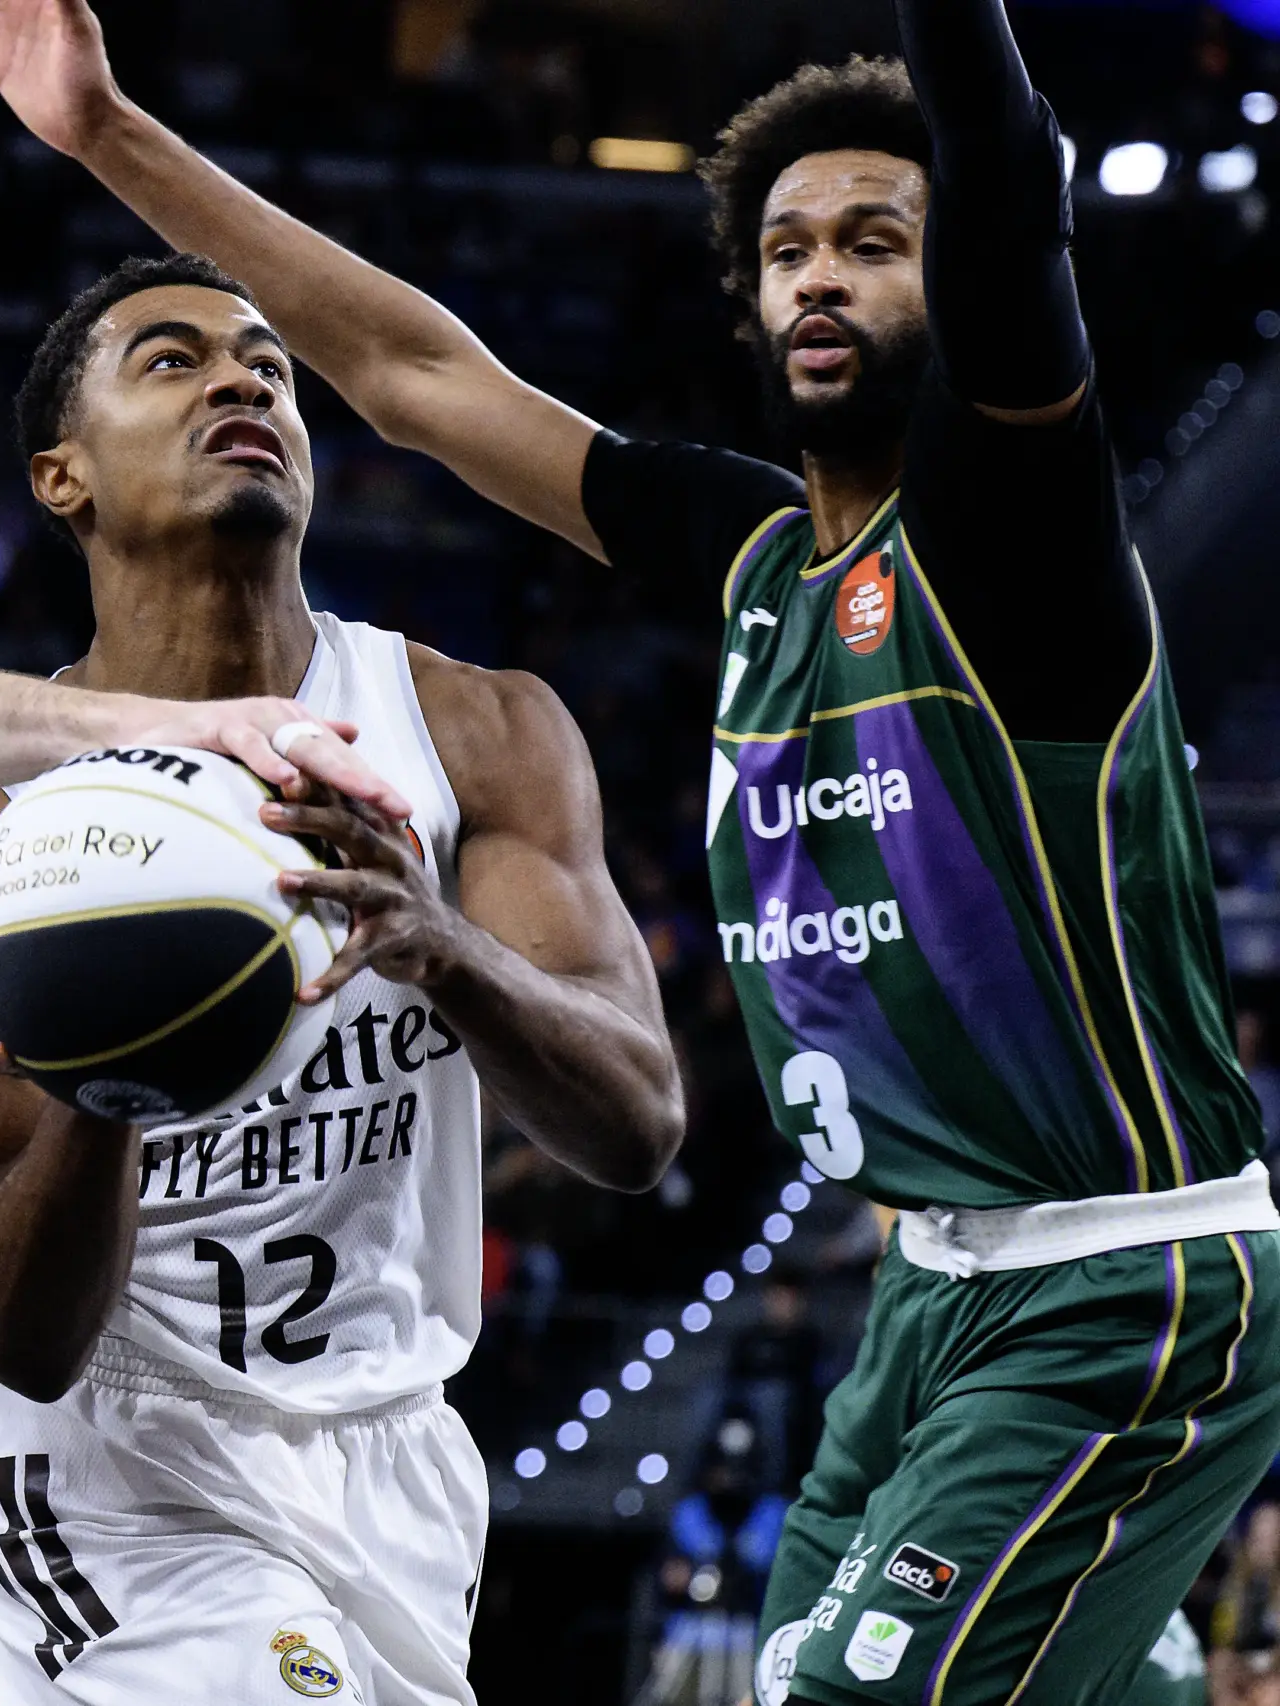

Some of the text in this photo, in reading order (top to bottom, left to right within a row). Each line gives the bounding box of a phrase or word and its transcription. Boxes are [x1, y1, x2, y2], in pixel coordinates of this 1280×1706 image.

[31, 867, 80, 888] 2026
[32, 831, 73, 856] del
[83, 825, 164, 867] Rey
[139, 1131, 223, 1199] FLY
[241, 1092, 417, 1190] BETTER
[781, 1051, 864, 1179] 3
[194, 1234, 337, 1373] 12
[891, 1560, 934, 1589] acb
